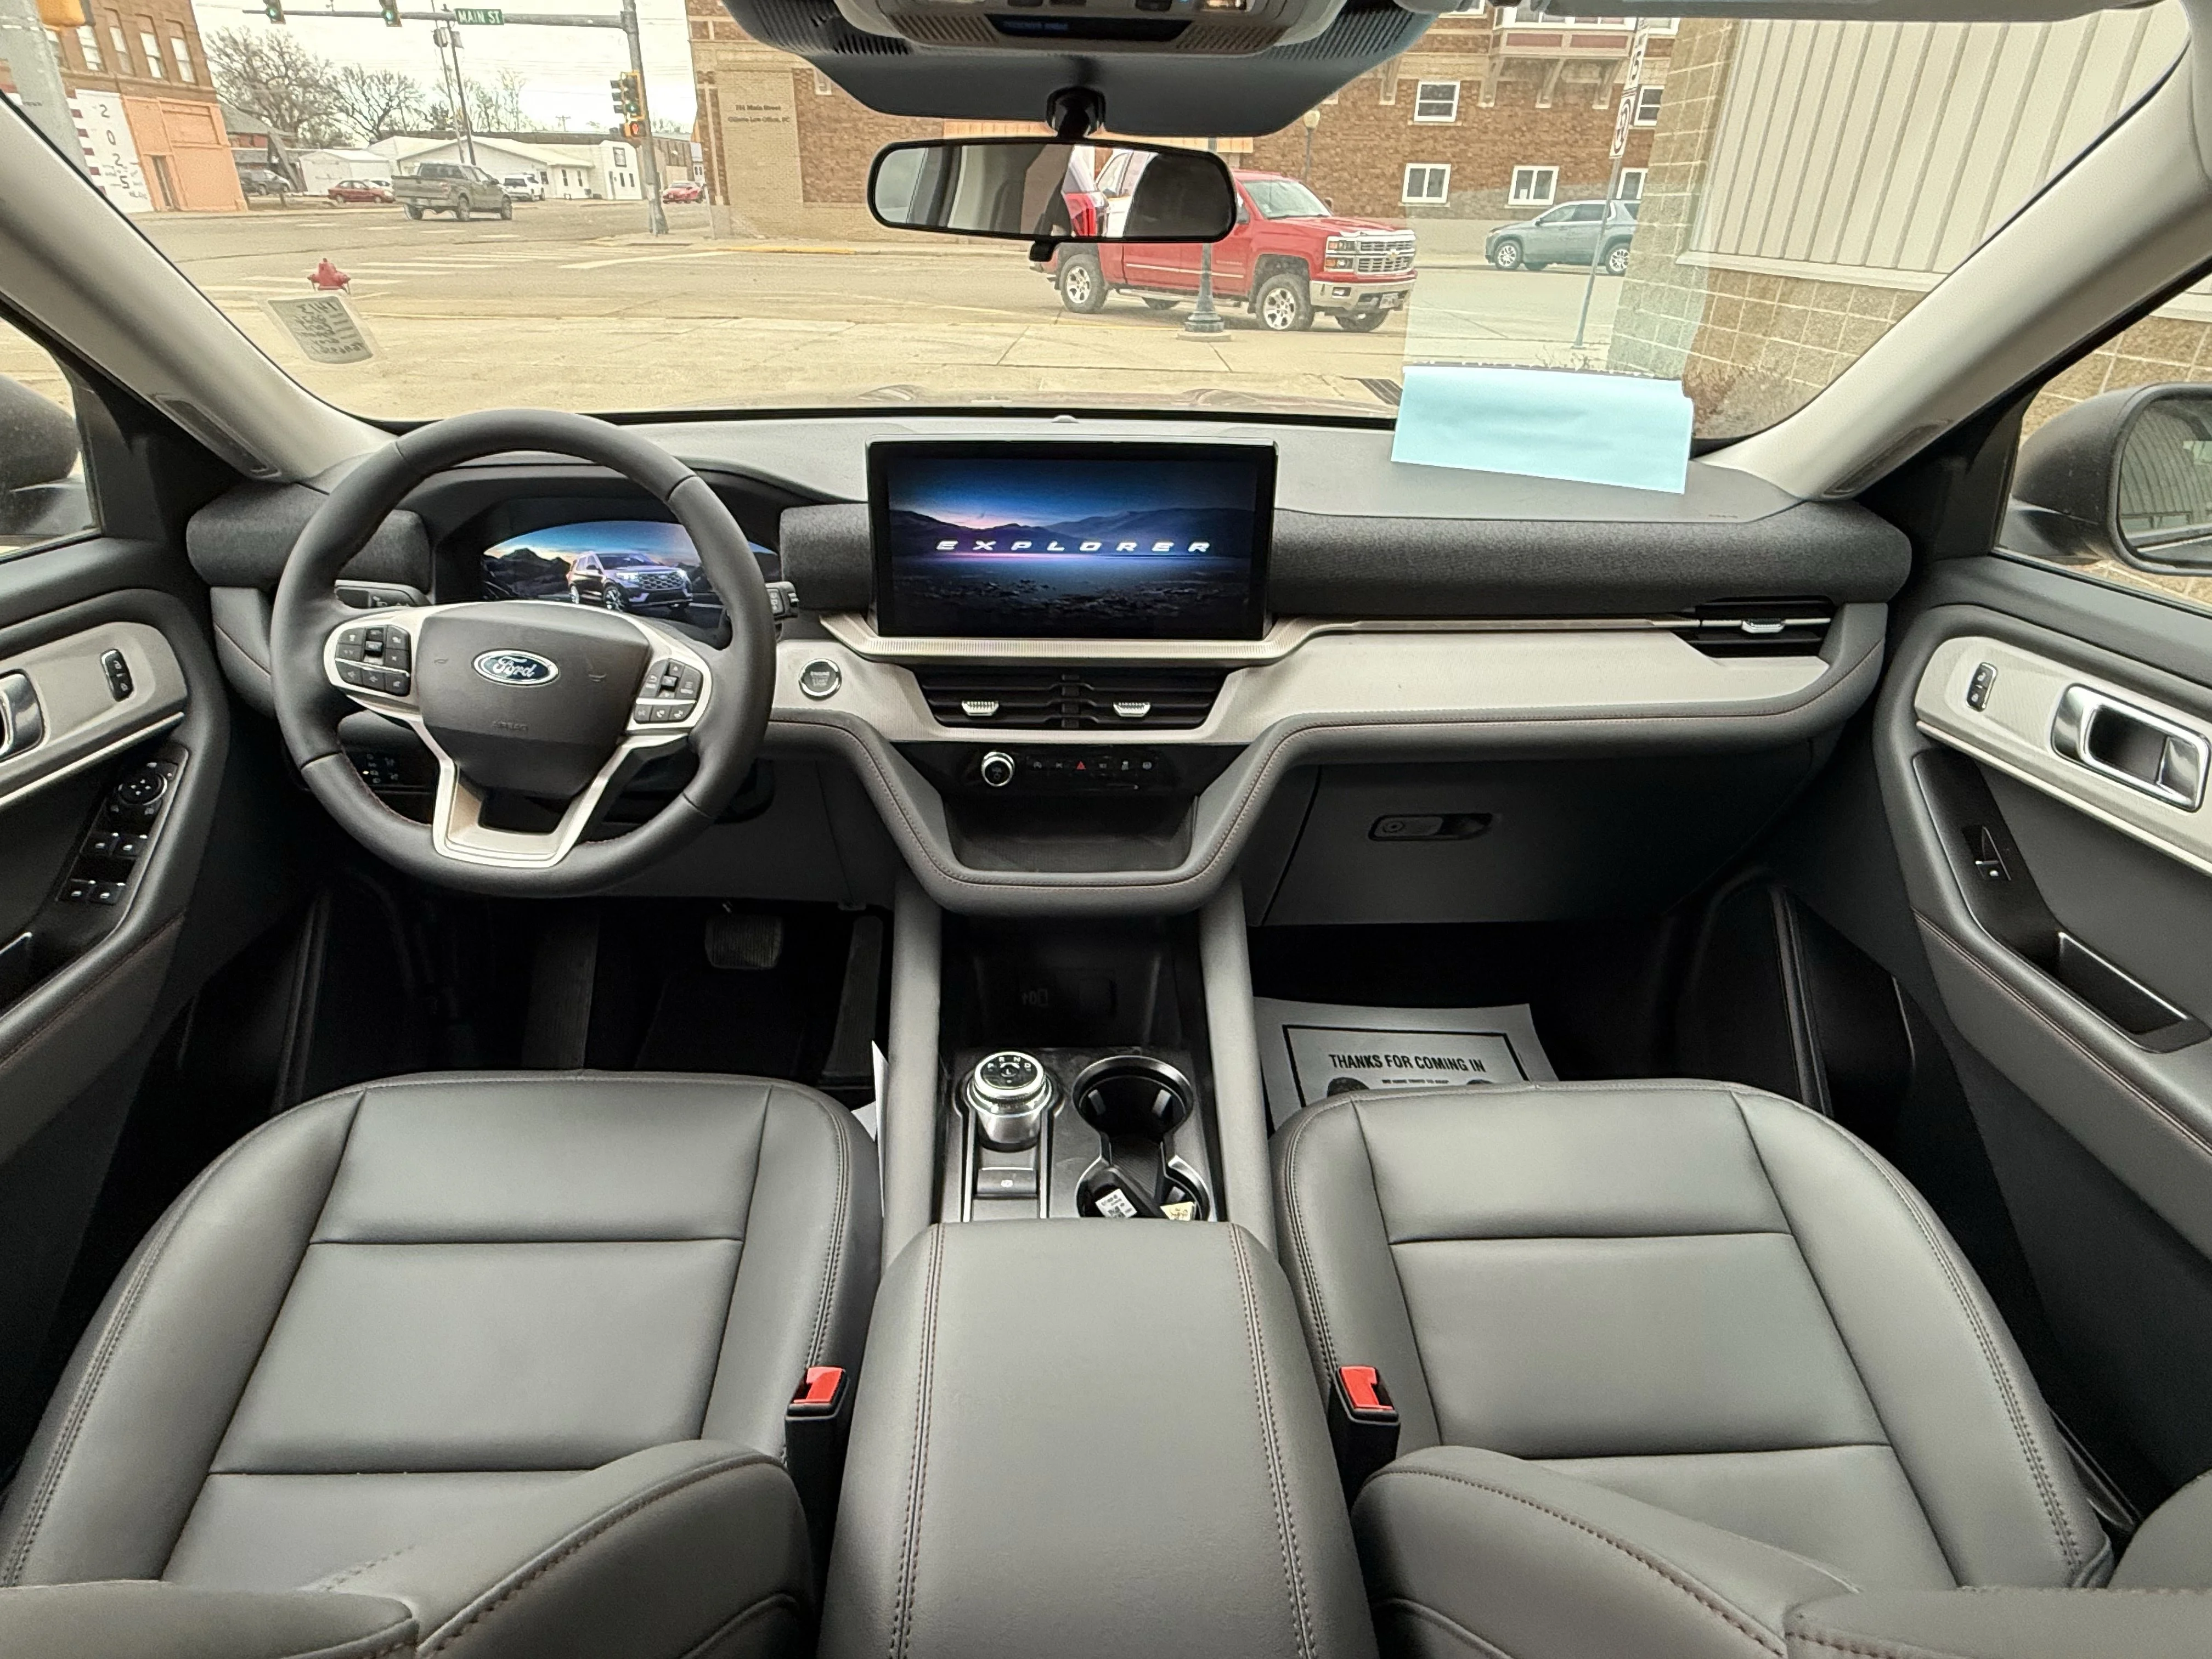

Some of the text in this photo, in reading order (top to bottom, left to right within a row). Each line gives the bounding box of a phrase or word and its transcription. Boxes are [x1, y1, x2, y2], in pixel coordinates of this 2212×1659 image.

[458, 10, 500, 24] MAIN ST
[936, 540, 1210, 553] EXPLORER
[493, 656, 538, 678] Ford
[1328, 1053, 1487, 1073] THANKS FOR COMING IN
